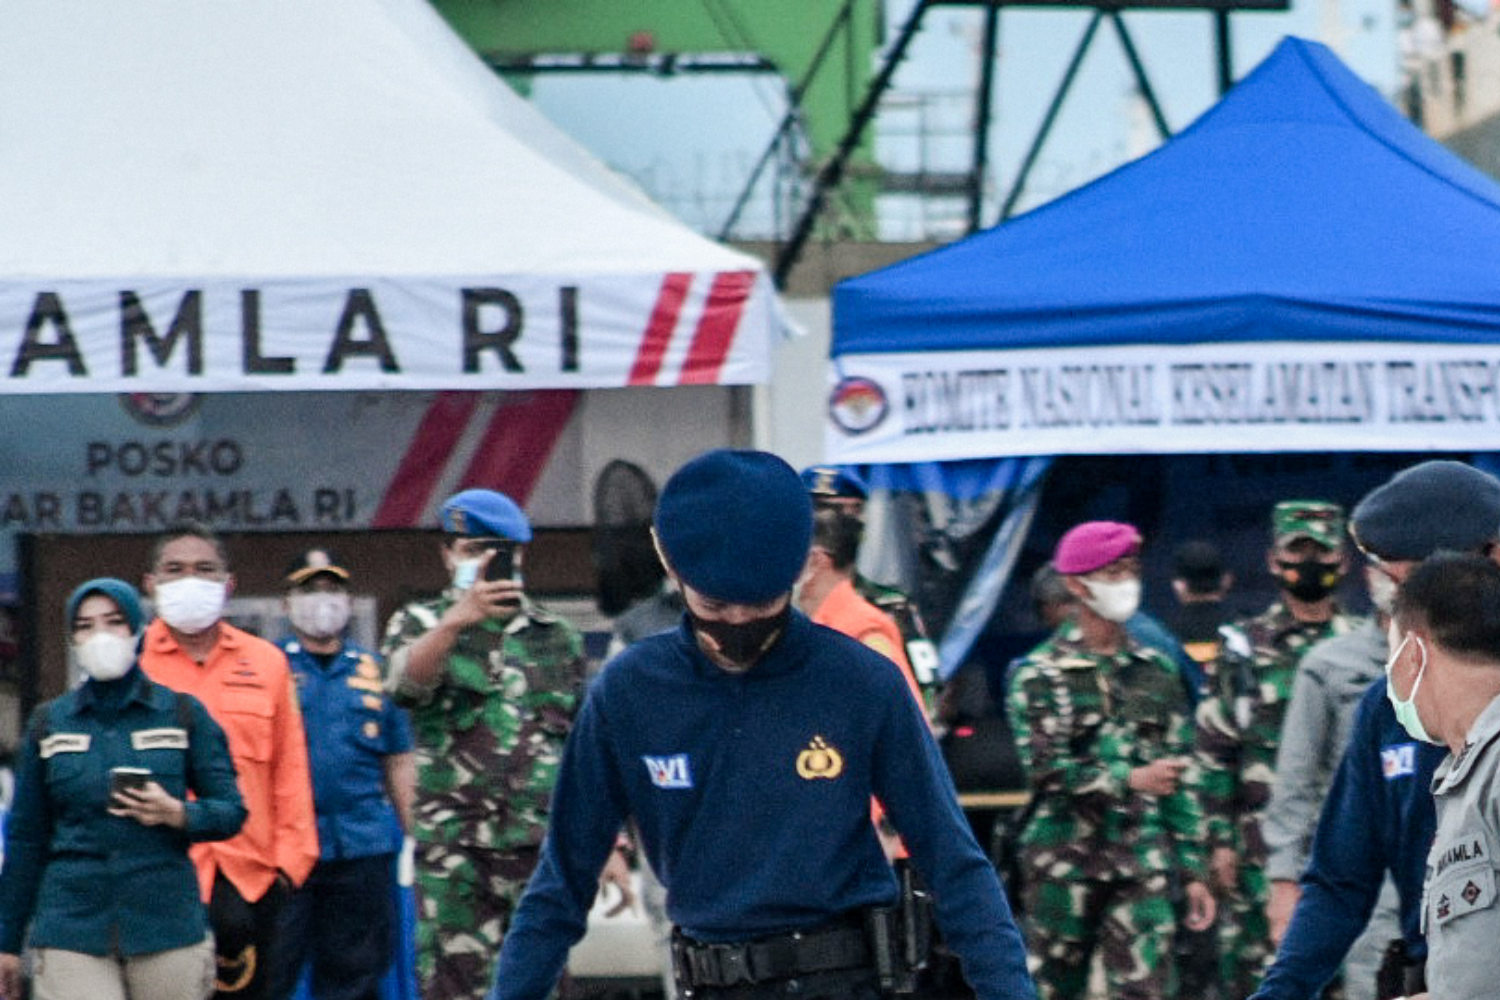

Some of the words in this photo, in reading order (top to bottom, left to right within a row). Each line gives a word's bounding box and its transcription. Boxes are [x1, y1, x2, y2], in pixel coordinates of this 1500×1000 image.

[10, 287, 399, 378] AMLA
[461, 284, 580, 375] RI
[1018, 363, 1160, 430] NASIONAL
[1169, 357, 1376, 428] KESELAMATAN
[86, 438, 244, 478] POSKO
[76, 486, 299, 527] BAKAMLA
[312, 486, 357, 524] RI
